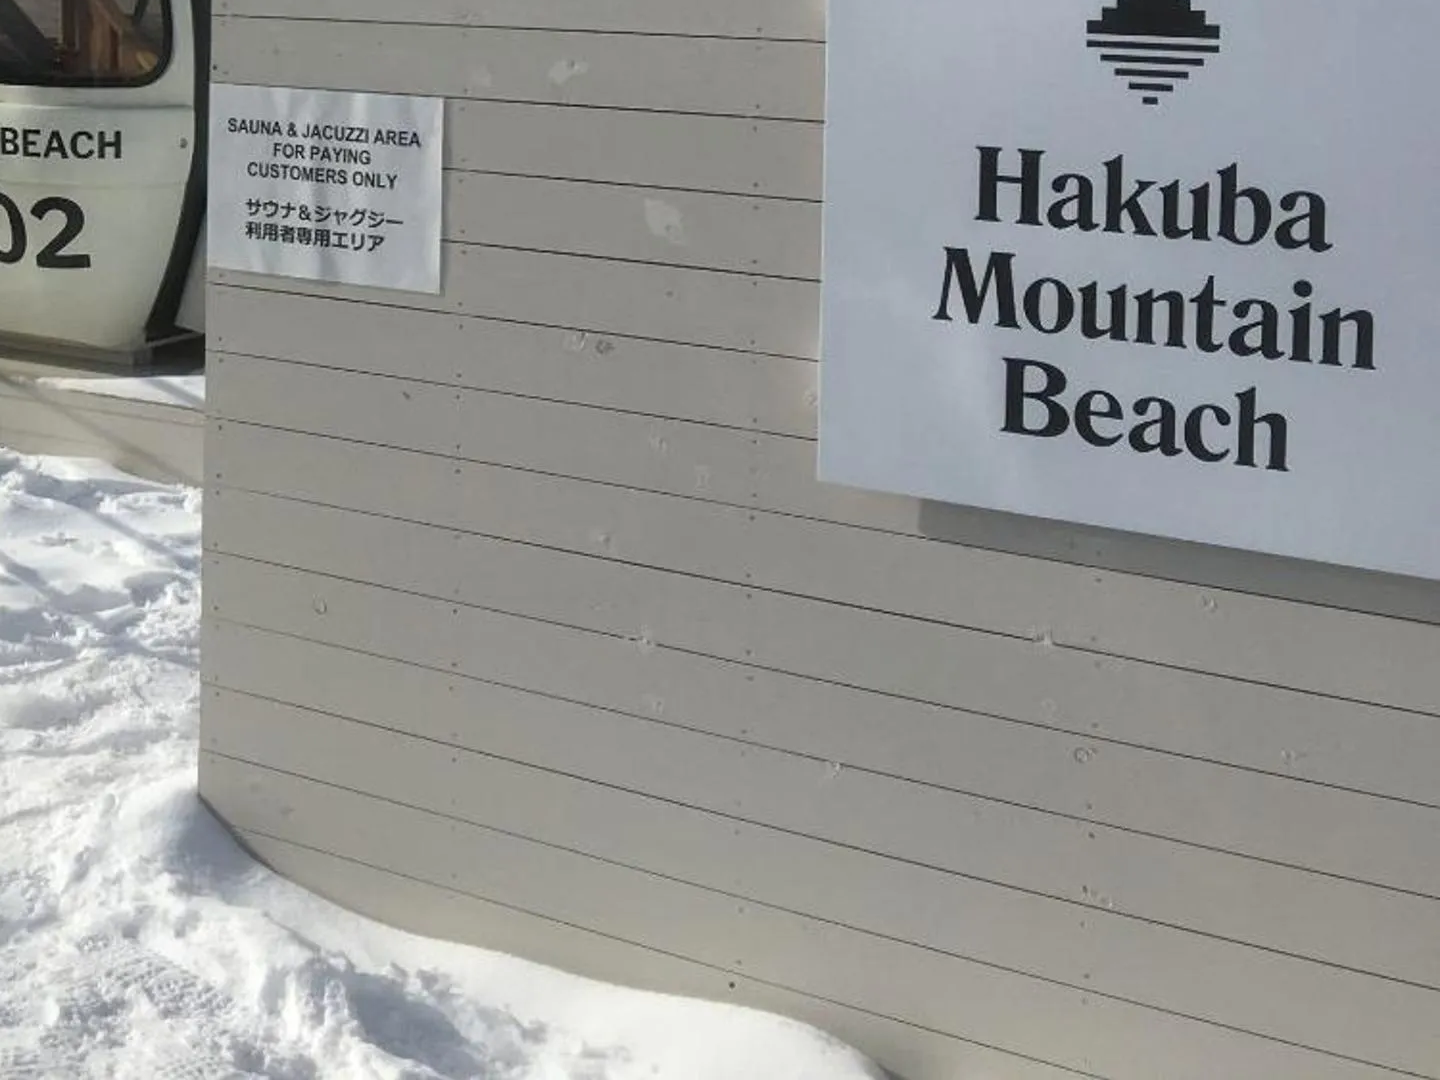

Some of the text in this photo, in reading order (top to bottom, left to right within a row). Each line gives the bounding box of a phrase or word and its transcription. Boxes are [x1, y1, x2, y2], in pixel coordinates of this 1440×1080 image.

[0, 127, 123, 160] BEACH
[227, 117, 422, 149] SAUNA & JACUZZI AREA
[273, 142, 372, 166] FOR PAYING
[246, 161, 398, 190] CUSTOMERS ONLY
[245, 198, 404, 229] サウナ&ジャグジー
[974, 145, 1333, 253] Hakuba
[245, 221, 385, 253] 利用者専用エリア
[932, 246, 1377, 370] Mountain
[1000, 356, 1289, 472] Beach
